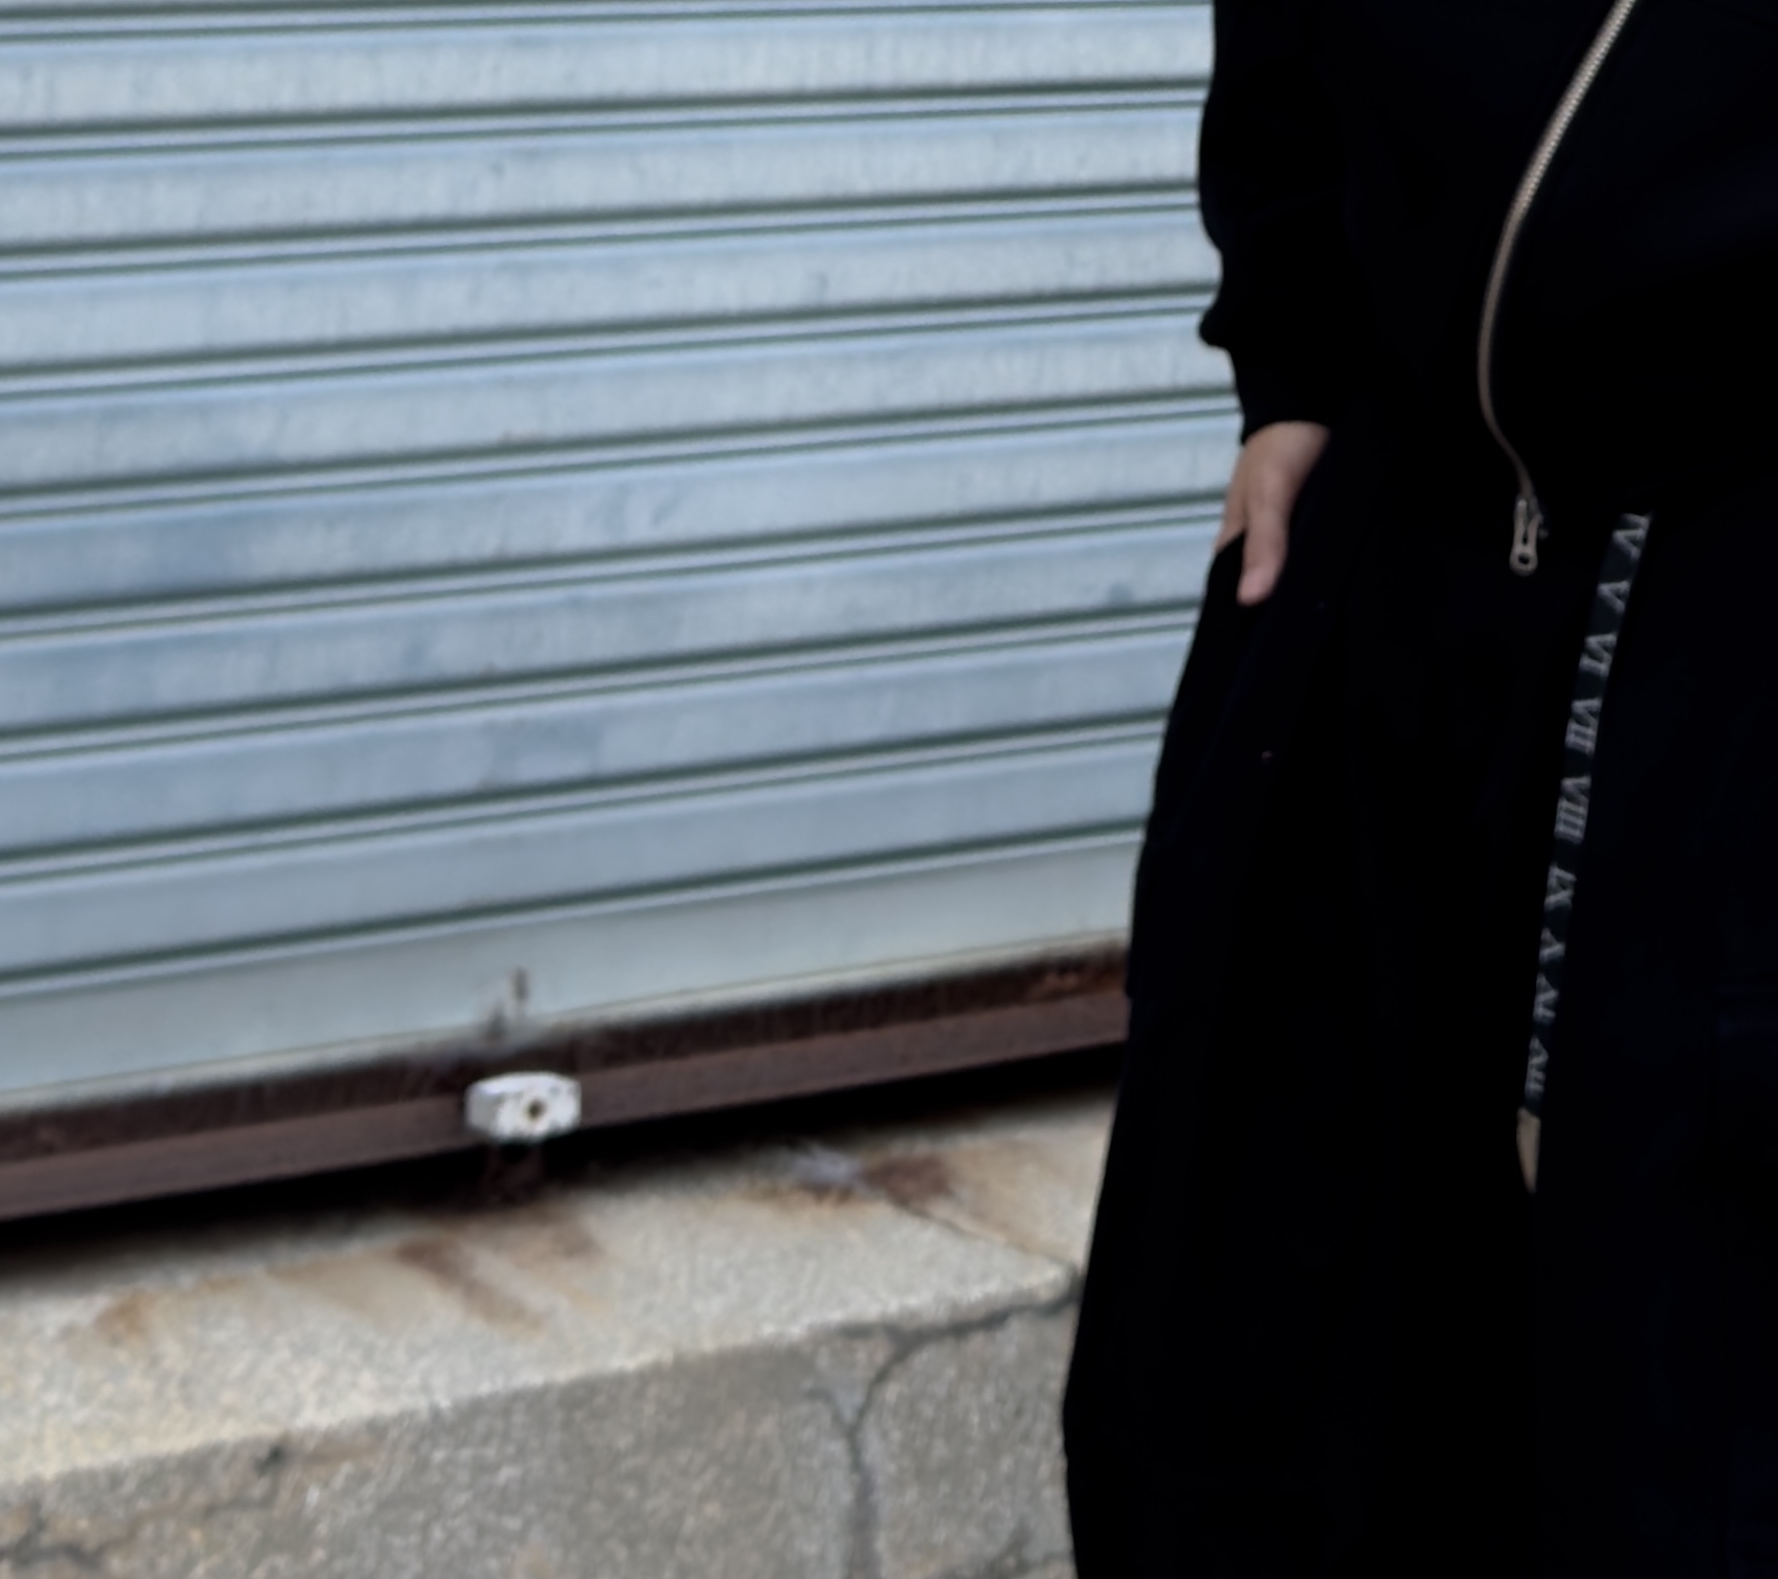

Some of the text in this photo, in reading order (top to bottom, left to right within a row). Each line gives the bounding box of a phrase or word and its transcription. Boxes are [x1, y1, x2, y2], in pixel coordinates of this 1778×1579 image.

[1597, 580, 1632, 614] V
[1578, 633, 1618, 677] VI
[1565, 697, 1602, 756] VII
[1554, 776, 1592, 844] VIII
